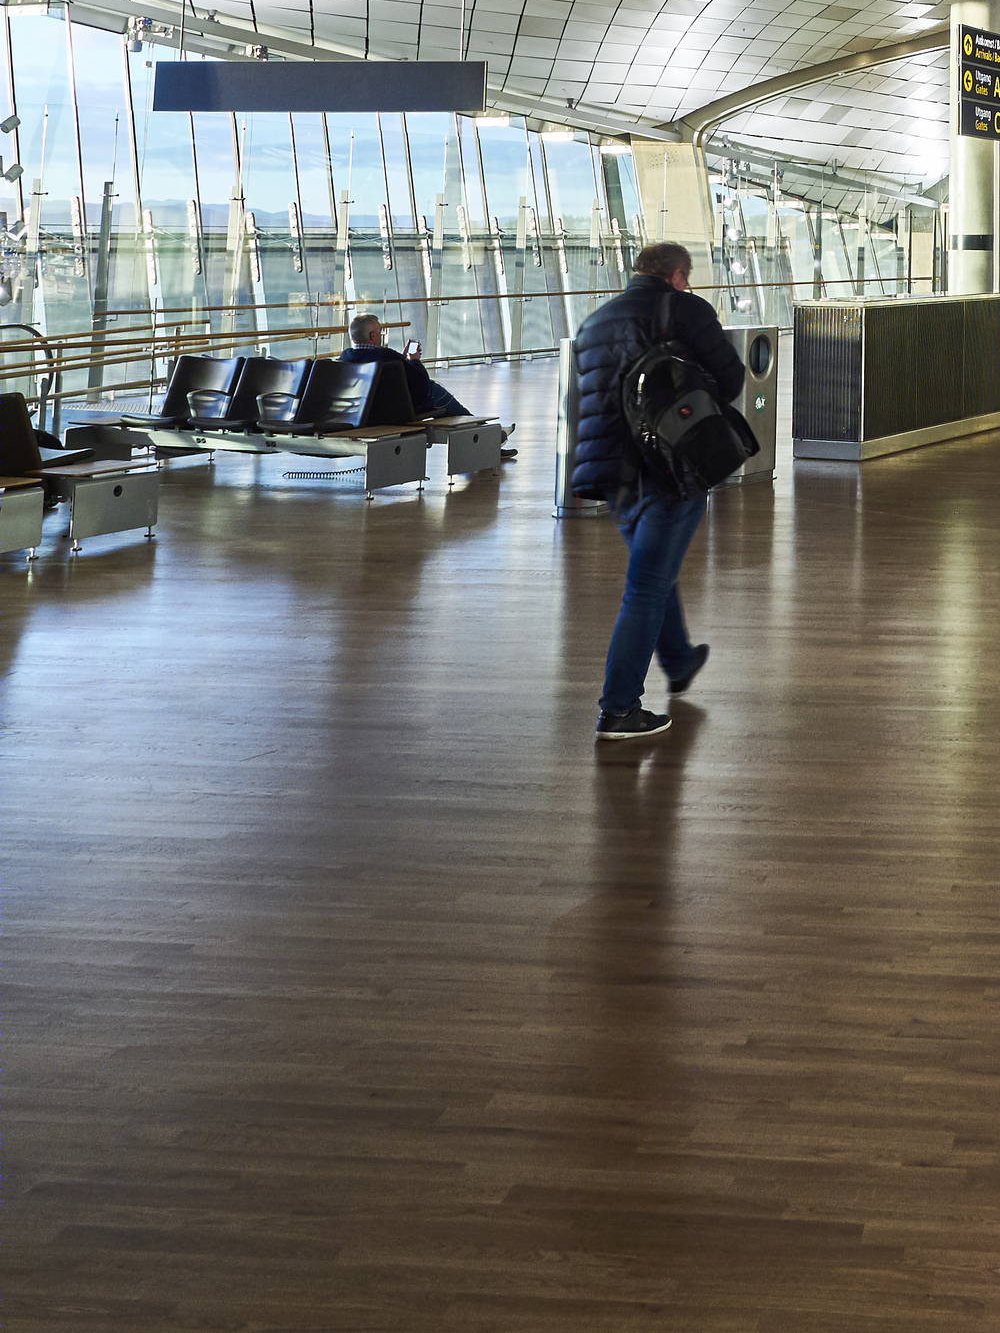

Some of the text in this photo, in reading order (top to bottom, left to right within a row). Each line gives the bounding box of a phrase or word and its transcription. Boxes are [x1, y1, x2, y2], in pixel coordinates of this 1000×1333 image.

[975, 47, 992, 61] Arrivals
[975, 70, 992, 85] Utgang
[975, 84, 988, 95] Gates
[975, 106, 992, 121] Utgang
[975, 120, 988, 131] Gates
